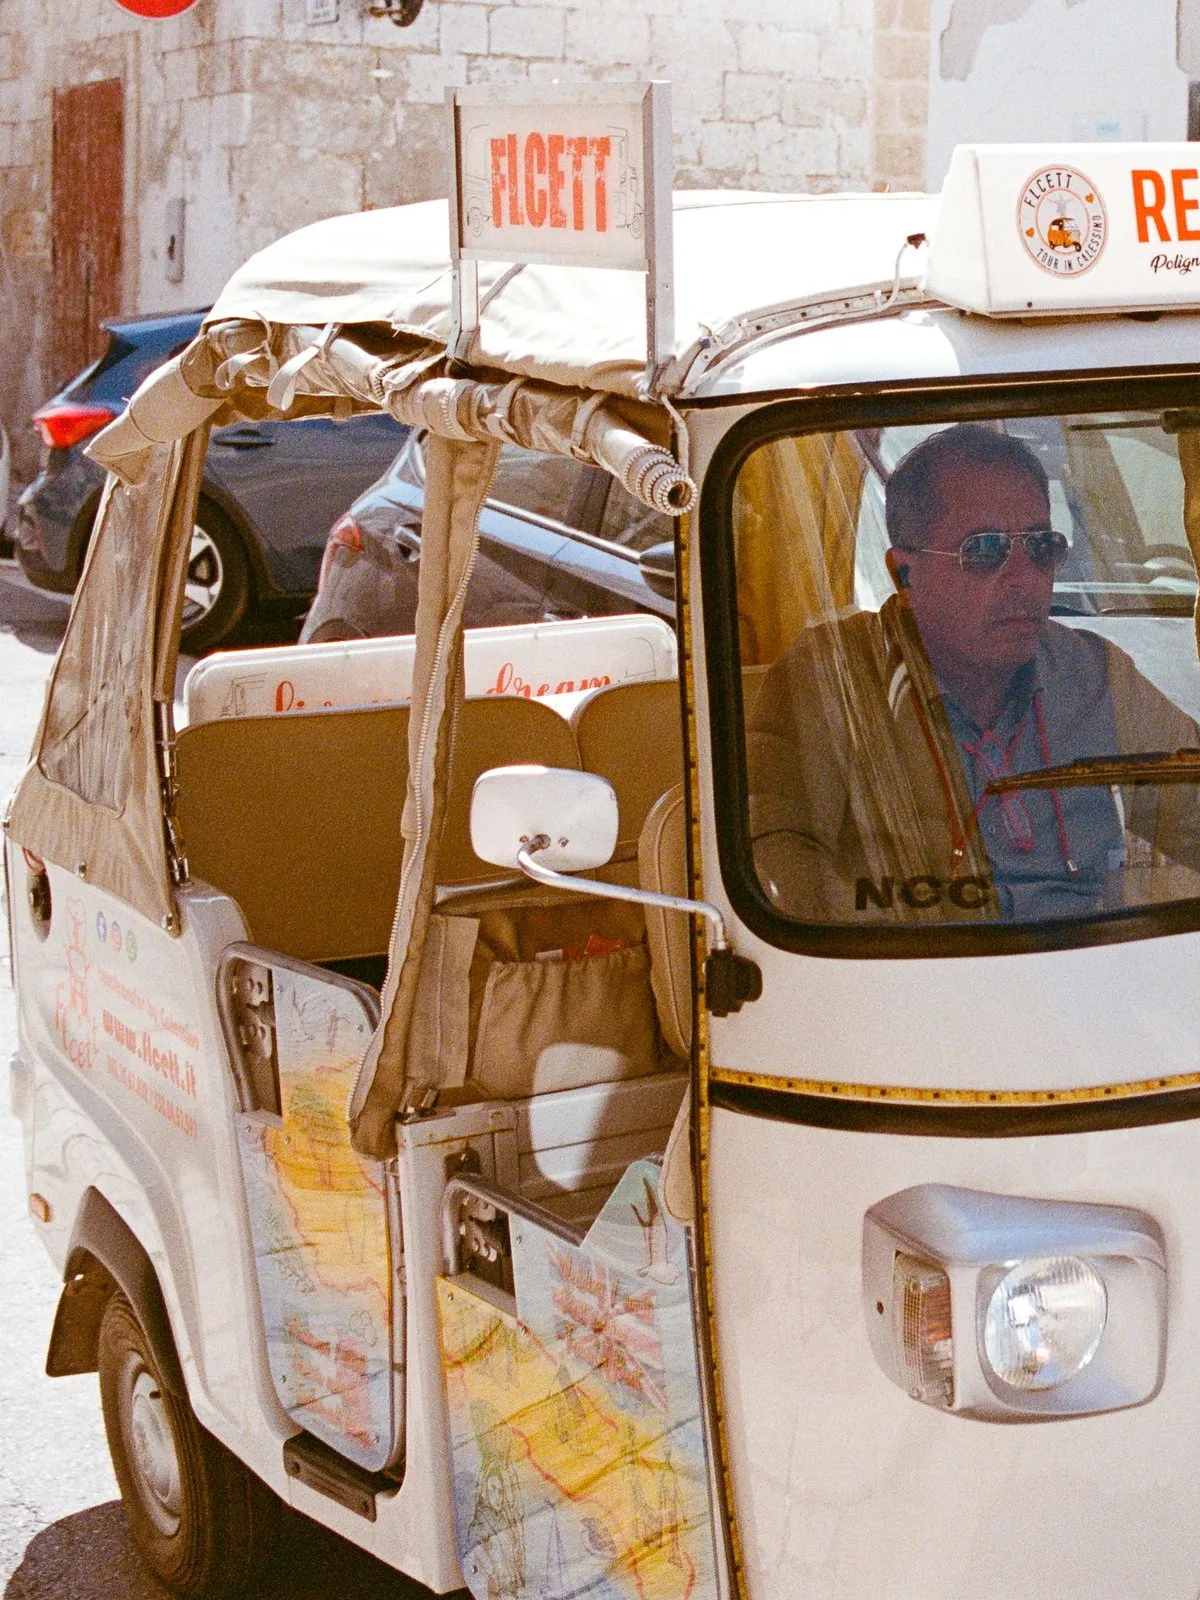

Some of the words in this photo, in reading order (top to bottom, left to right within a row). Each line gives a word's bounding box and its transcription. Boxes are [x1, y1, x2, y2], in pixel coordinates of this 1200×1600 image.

[490, 131, 611, 232] FLCETT
[1024, 172, 1073, 208] FLCETT
[1036, 247, 1059, 270] TOUR
[1064, 260, 1074, 271] IN
[1076, 214, 1103, 267] CALESSINO
[854, 874, 989, 911] NCC
